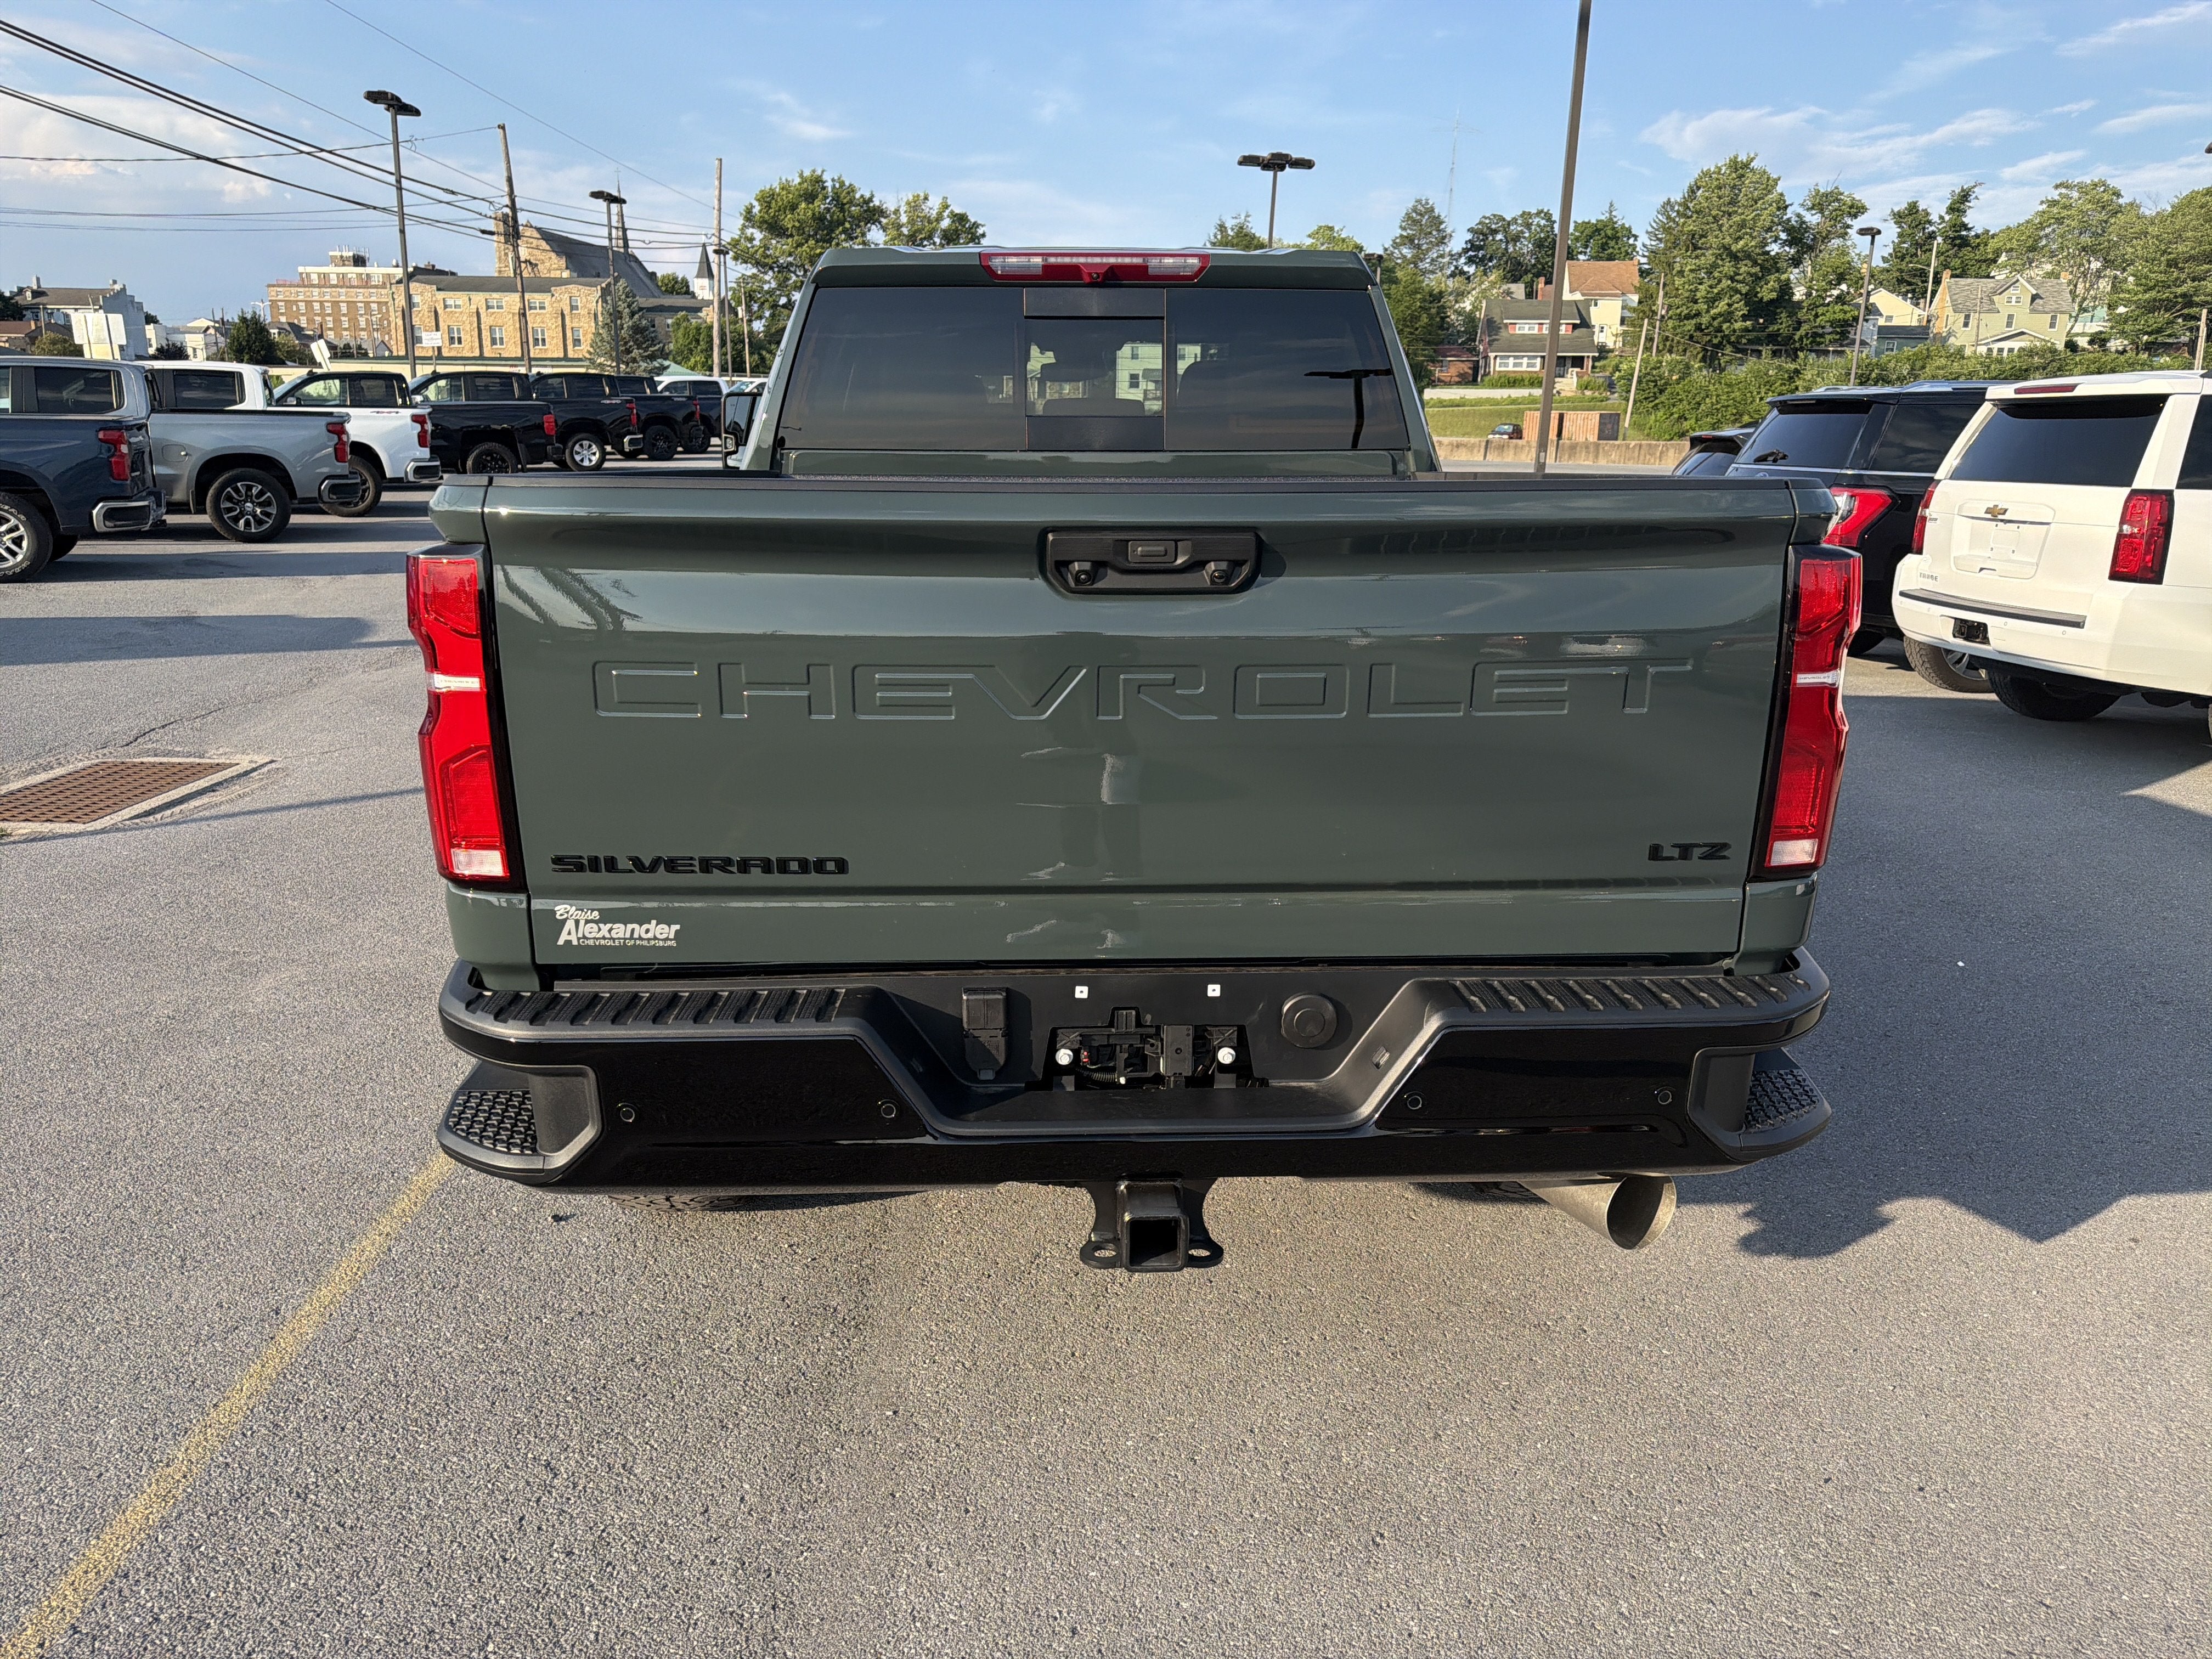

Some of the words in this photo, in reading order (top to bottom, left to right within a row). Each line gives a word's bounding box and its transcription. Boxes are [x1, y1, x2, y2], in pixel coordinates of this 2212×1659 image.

[593, 658, 1694, 720] CHEVROLET
[1648, 842, 1731, 861] LTZ
[550, 854, 849, 875] SILVERADO
[554, 904, 600, 920] Blaise
[557, 919, 681, 945] Alexander
